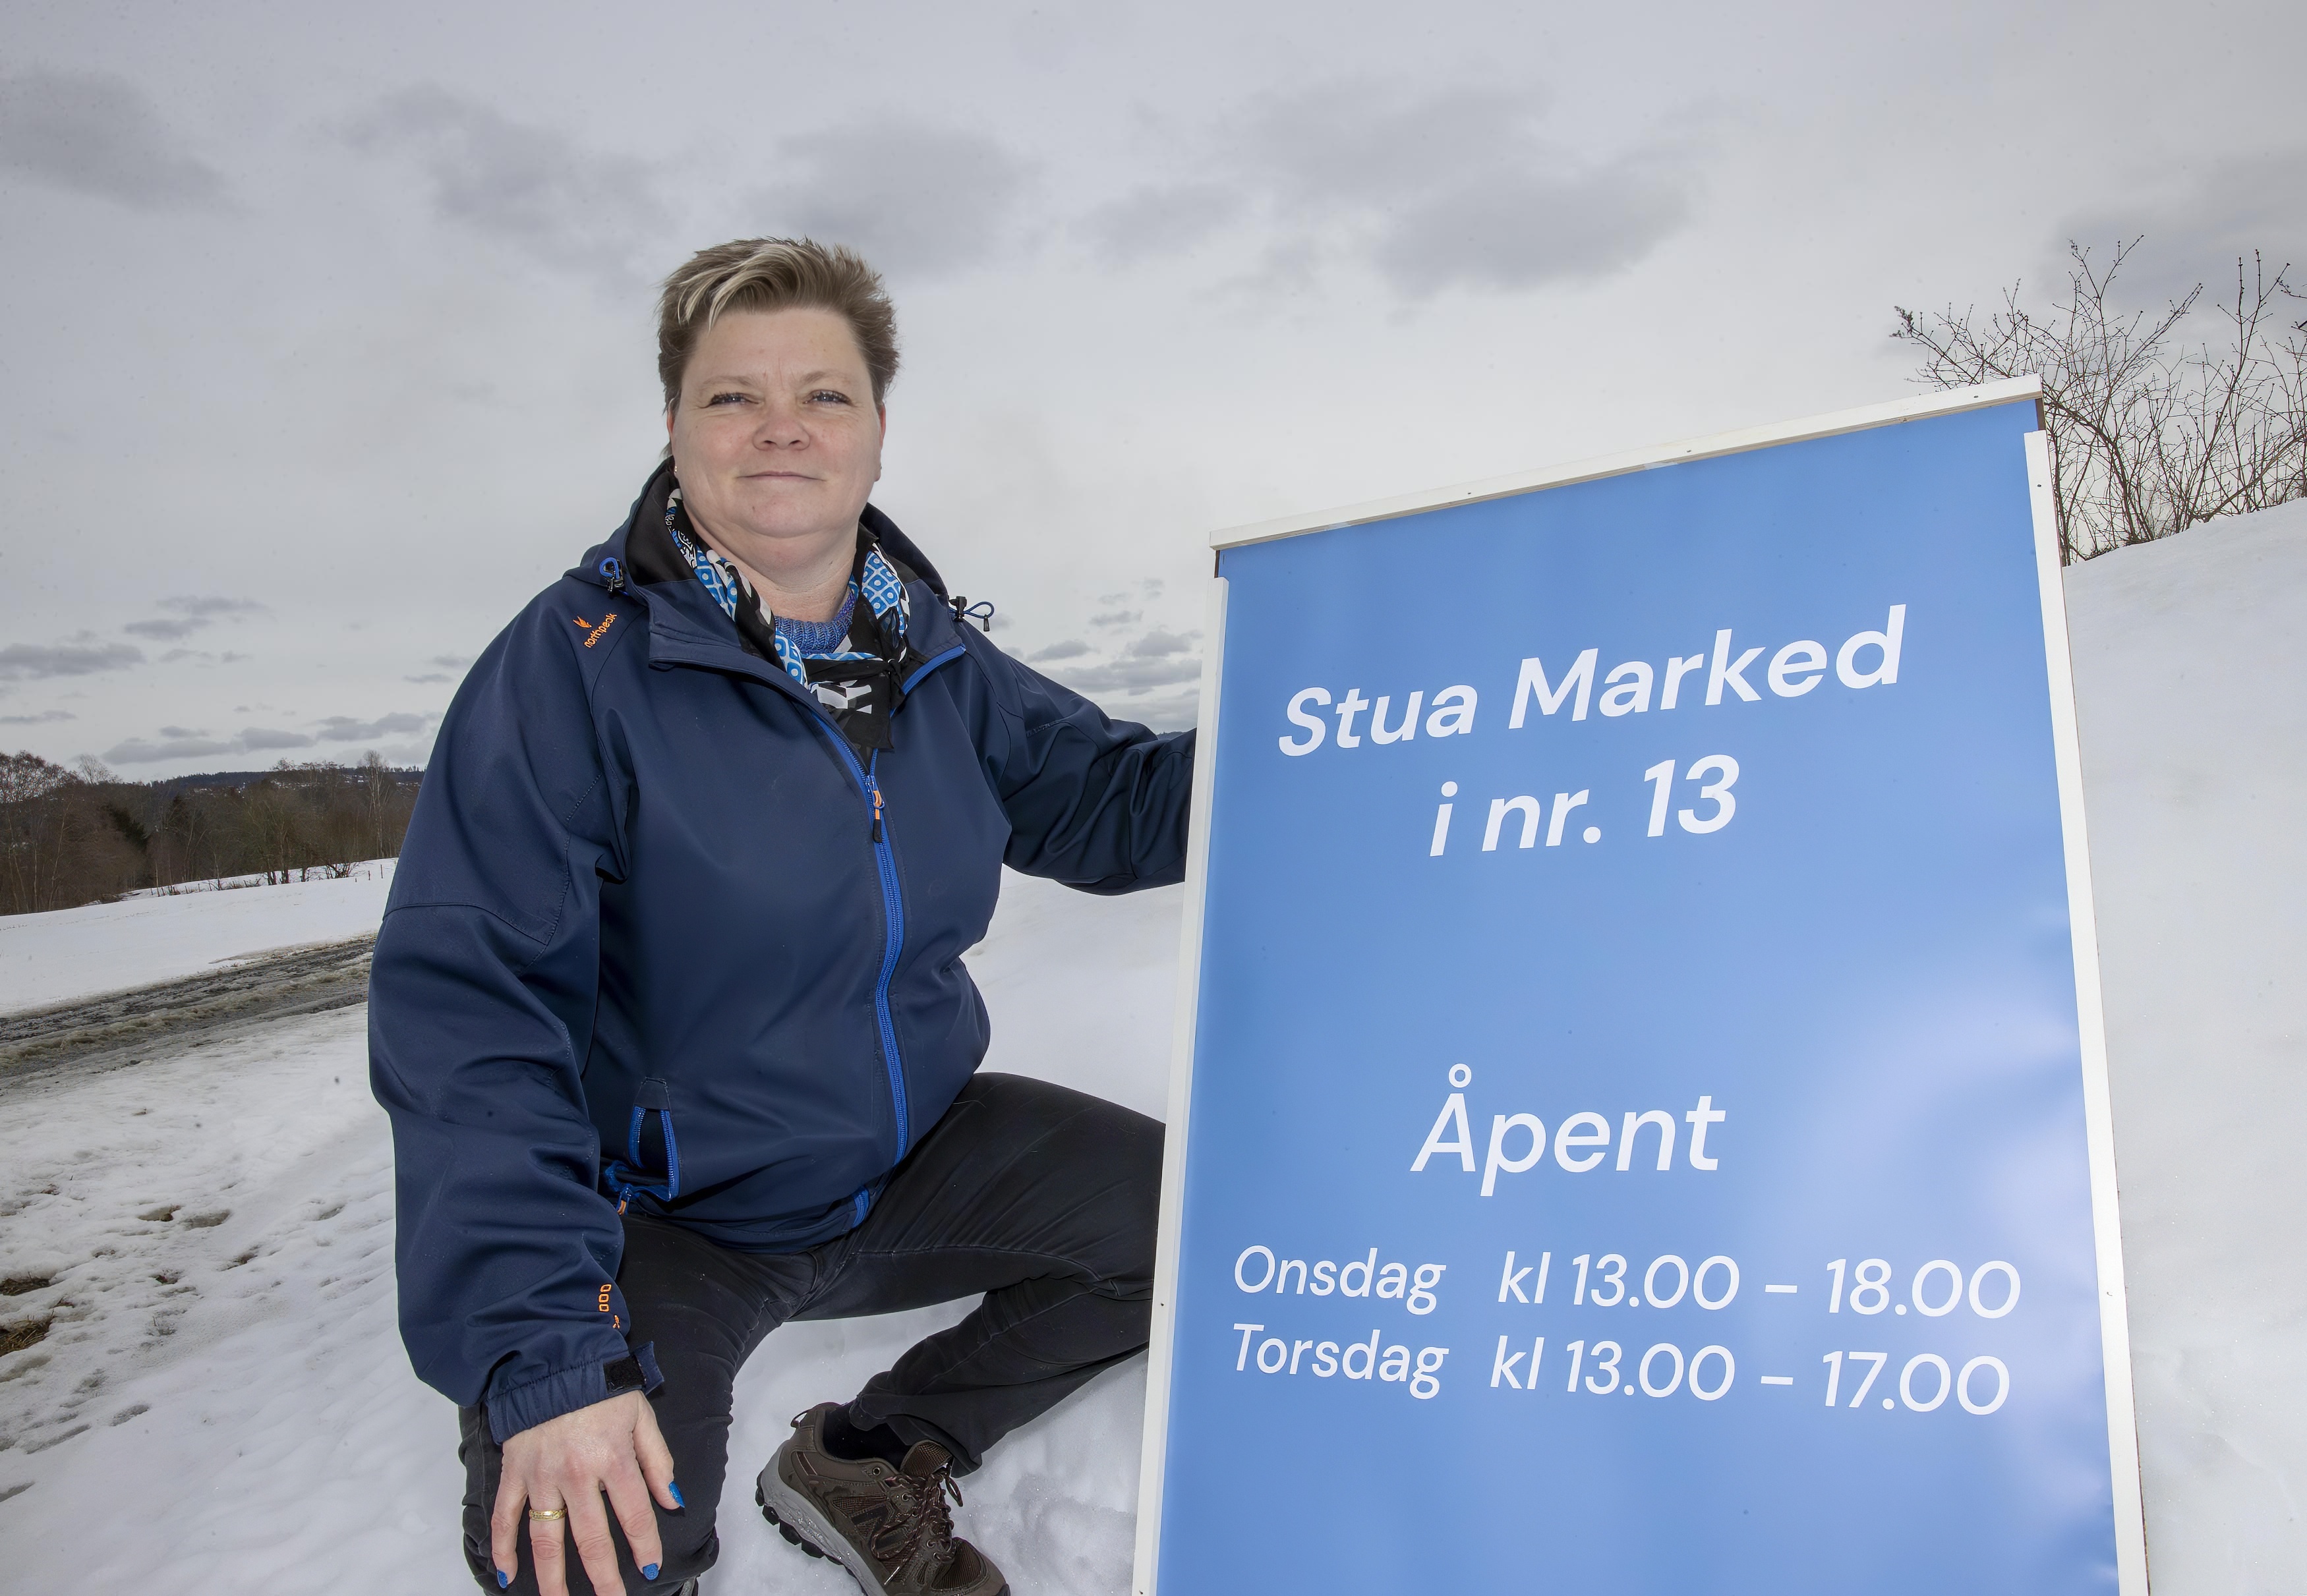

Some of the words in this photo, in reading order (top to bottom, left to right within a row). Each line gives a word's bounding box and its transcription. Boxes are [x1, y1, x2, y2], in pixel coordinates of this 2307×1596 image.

[1278, 684, 1478, 757] Stua
[1507, 603, 1907, 729] Marked
[1429, 780, 1459, 857] i
[1481, 788, 1602, 852] nr.
[1643, 754, 1740, 838] 13
[1409, 1062, 1727, 1197] Åpent
[1234, 1244, 1447, 1316] Onsdag
[1498, 1250, 1552, 1305] kl
[1572, 1253, 1741, 1311] 13.00
[1825, 1257, 2022, 1320] 18.00
[1233, 1323, 1450, 1400] Torsdag
[1490, 1334, 1545, 1390] kl
[1566, 1339, 1736, 1402] 13.00
[1822, 1350, 2012, 1416] 17.00
